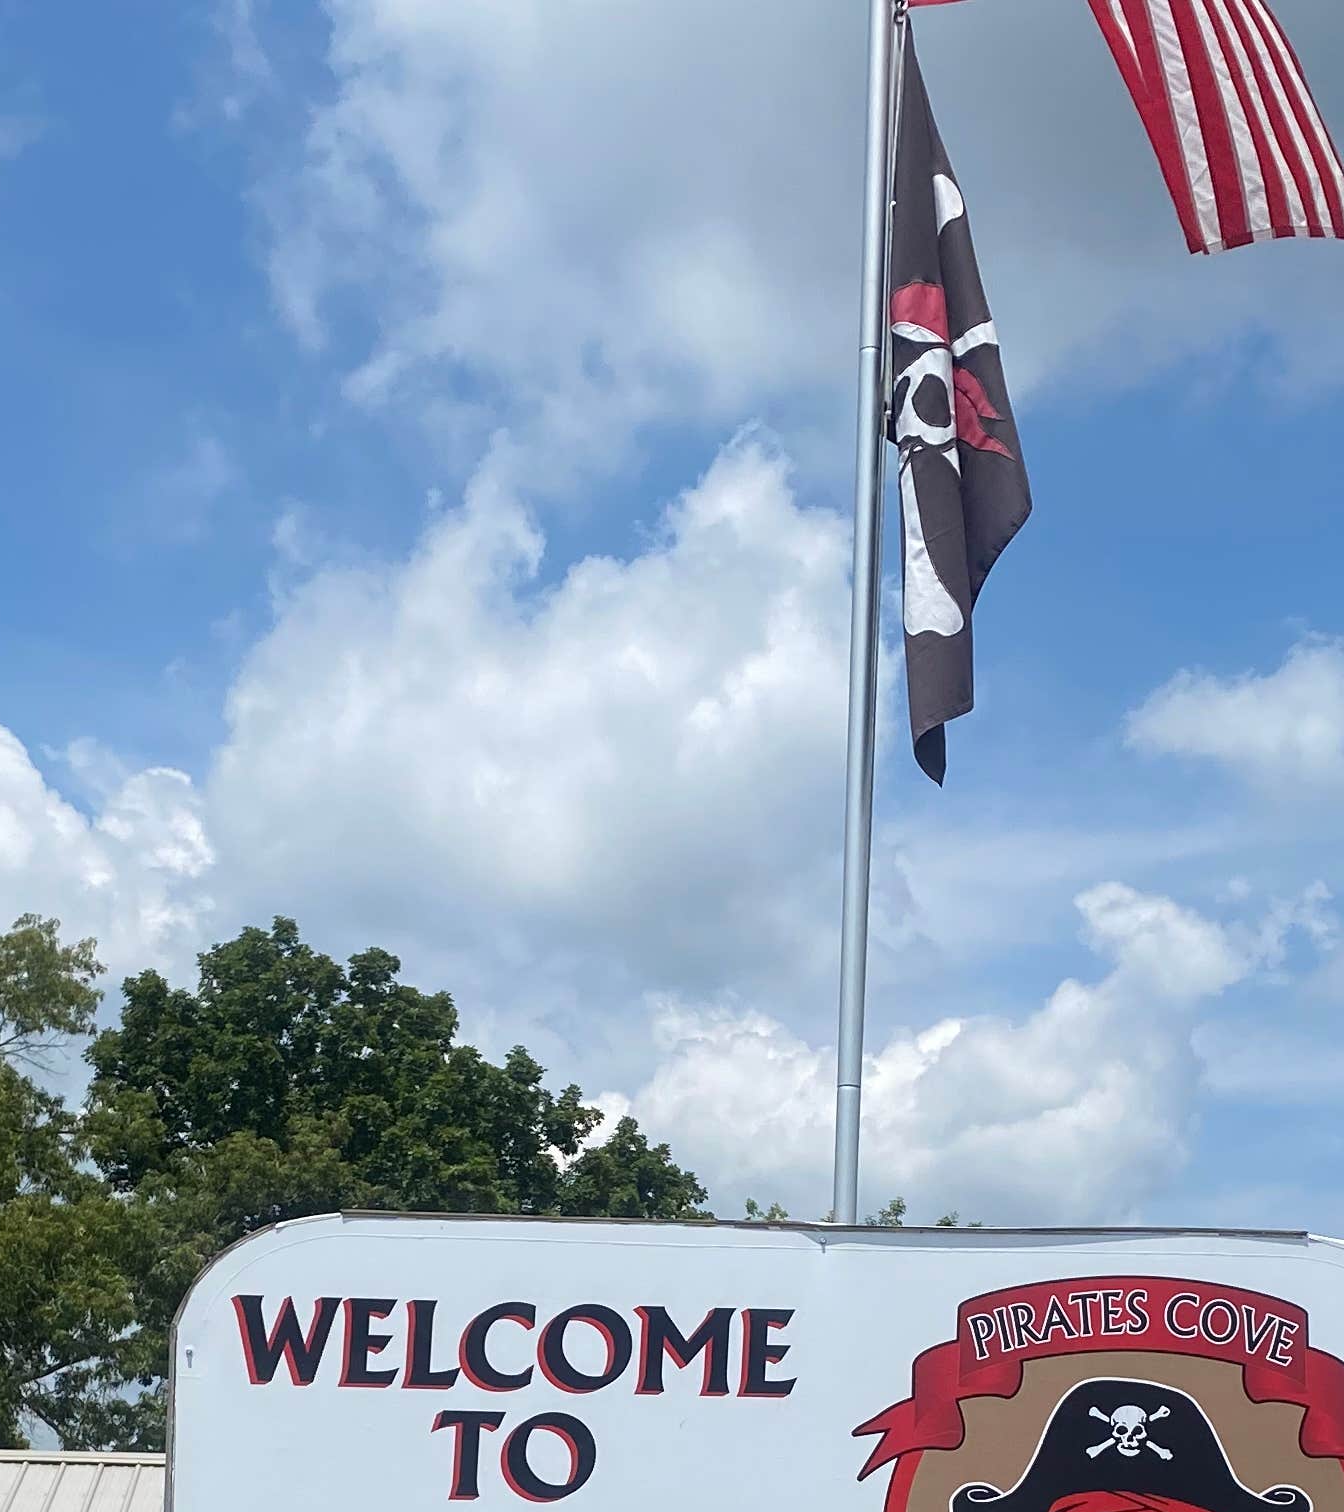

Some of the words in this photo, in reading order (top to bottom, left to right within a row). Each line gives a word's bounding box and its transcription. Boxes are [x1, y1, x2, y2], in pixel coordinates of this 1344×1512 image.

[231, 1294, 797, 1398] WELCOME
[966, 1288, 1150, 1361] PIRATES
[1164, 1292, 1300, 1368] COVE
[431, 1410, 596, 1502] TO
